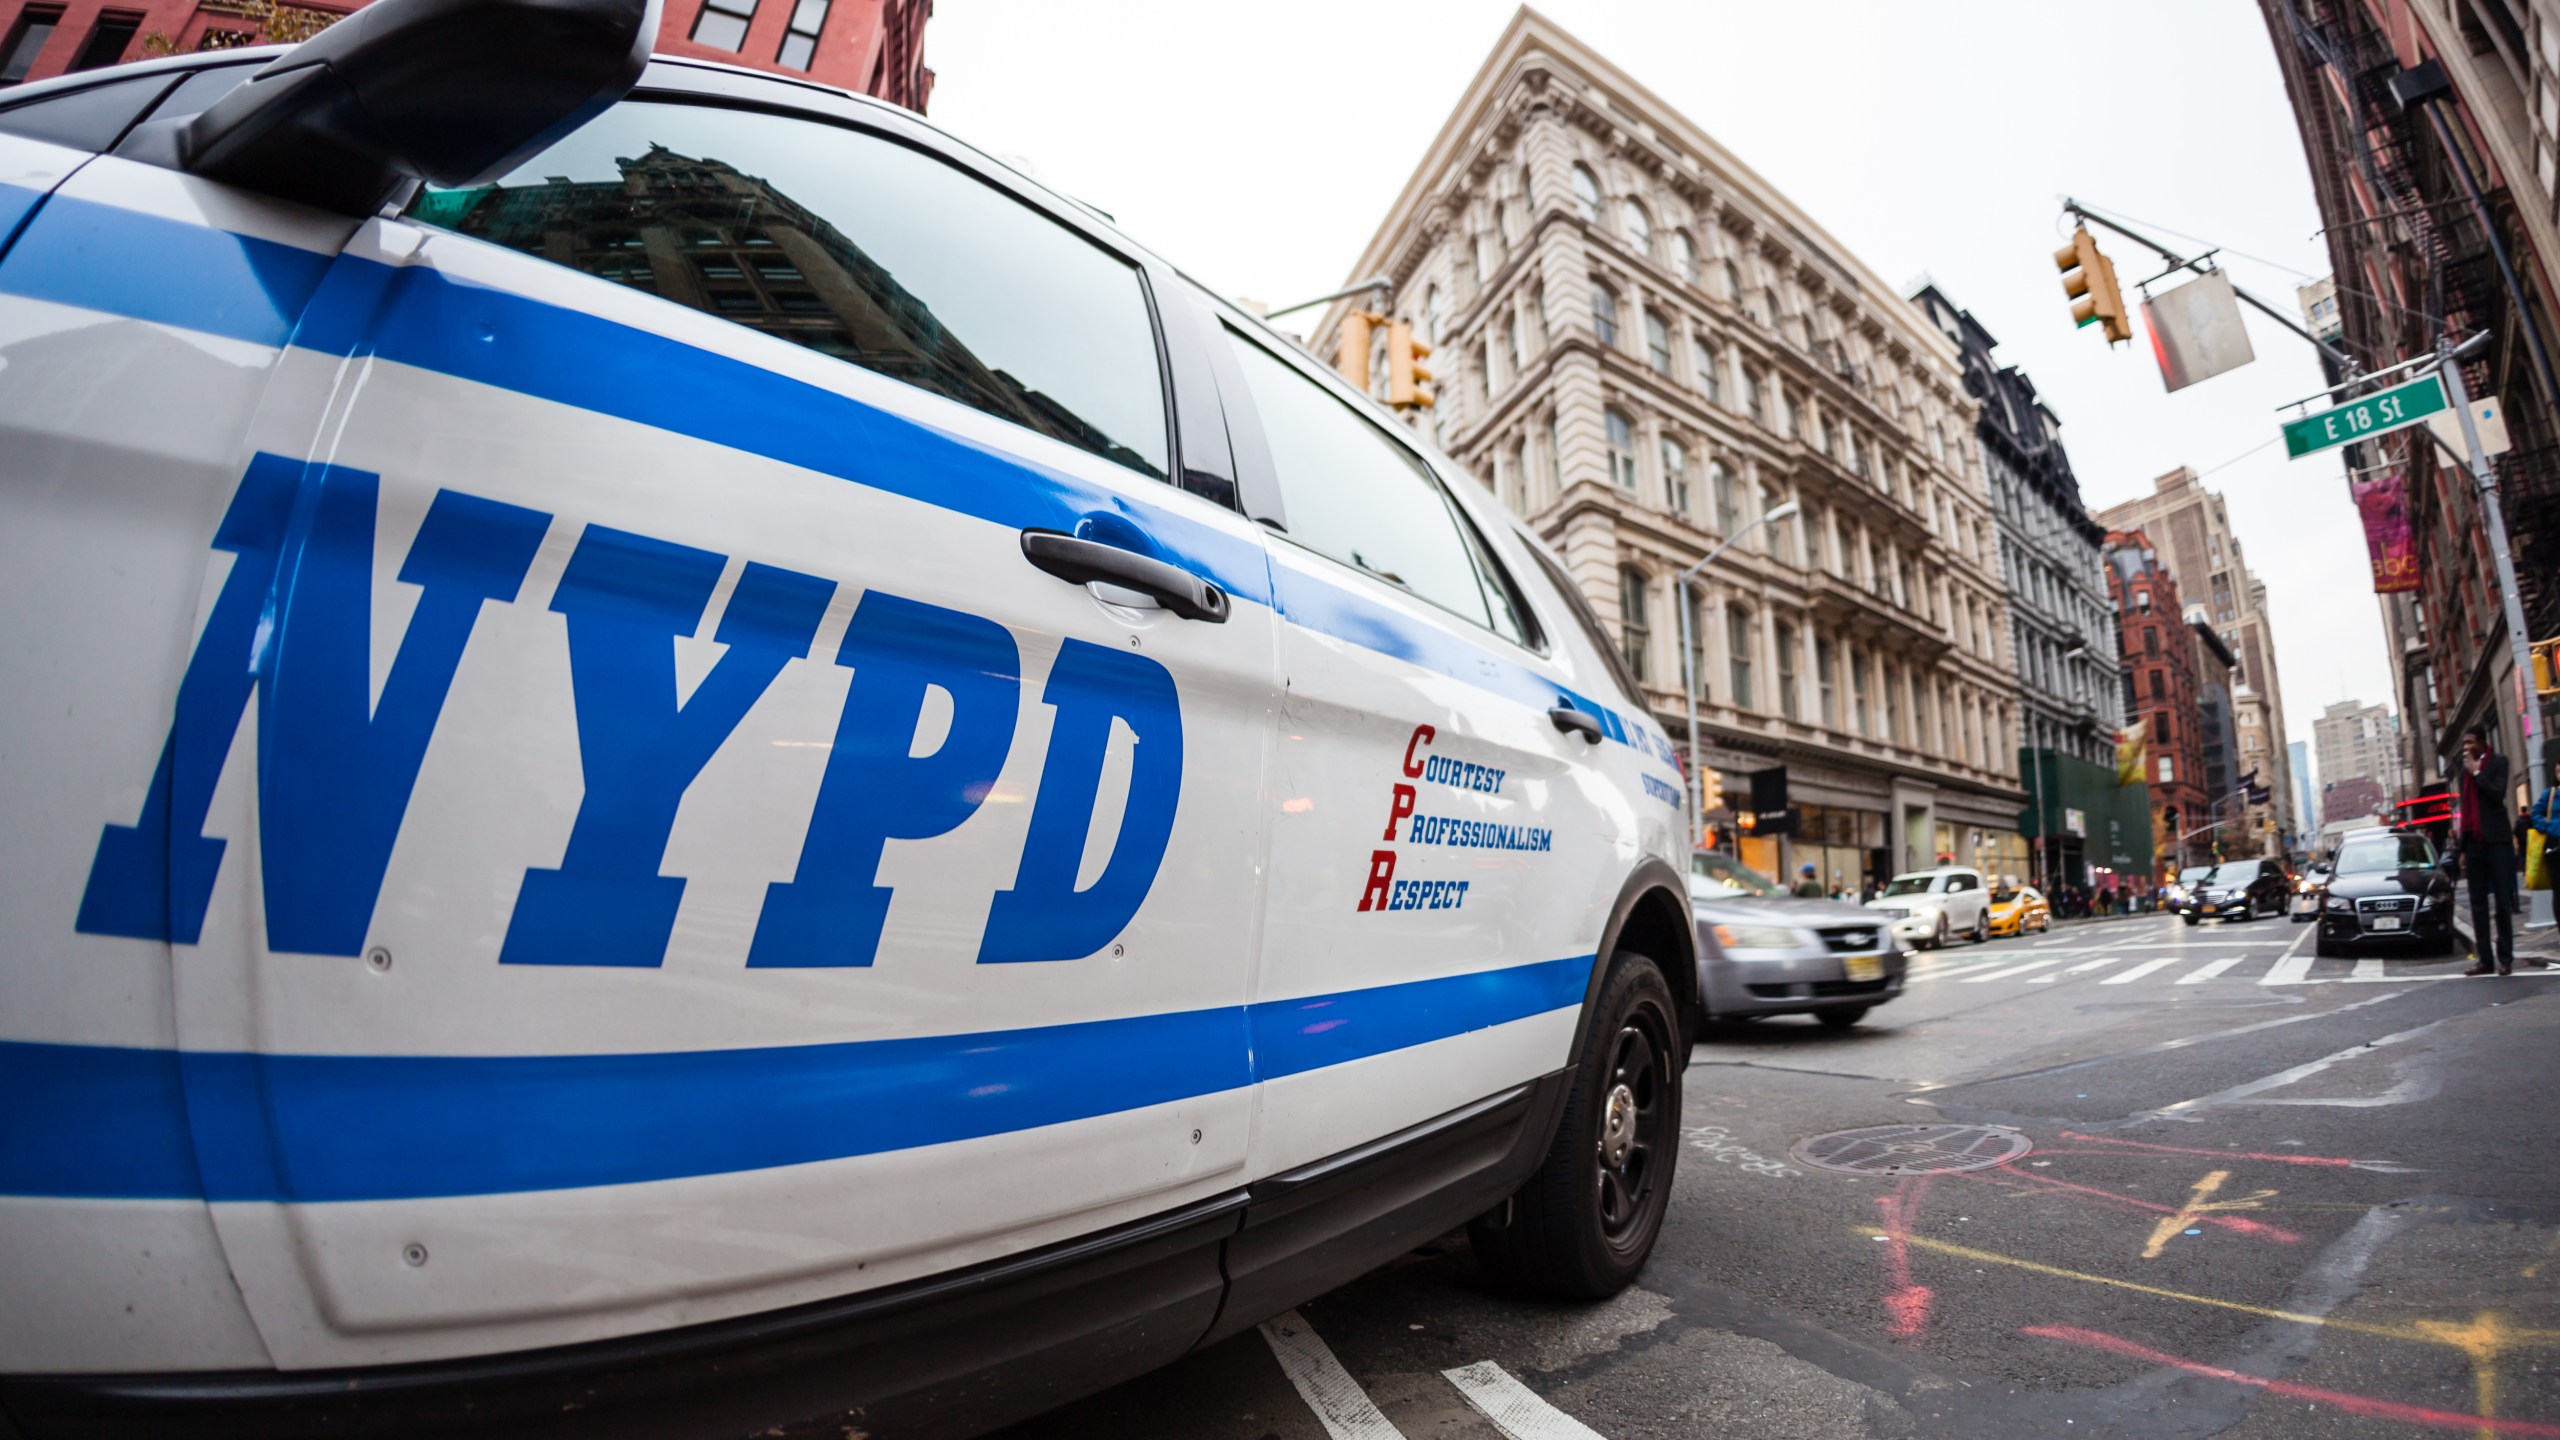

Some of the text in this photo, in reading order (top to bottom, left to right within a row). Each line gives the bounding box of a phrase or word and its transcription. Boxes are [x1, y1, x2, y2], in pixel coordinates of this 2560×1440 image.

[2324, 395, 2404, 440] E 18 St
[2371, 541, 2416, 577] abc
[76, 451, 1184, 968] NYPD
[1402, 724, 1505, 793] COURTESY
[1383, 783, 1552, 851] PROFESSIONALISM
[1357, 850, 1469, 912] RESPECT
